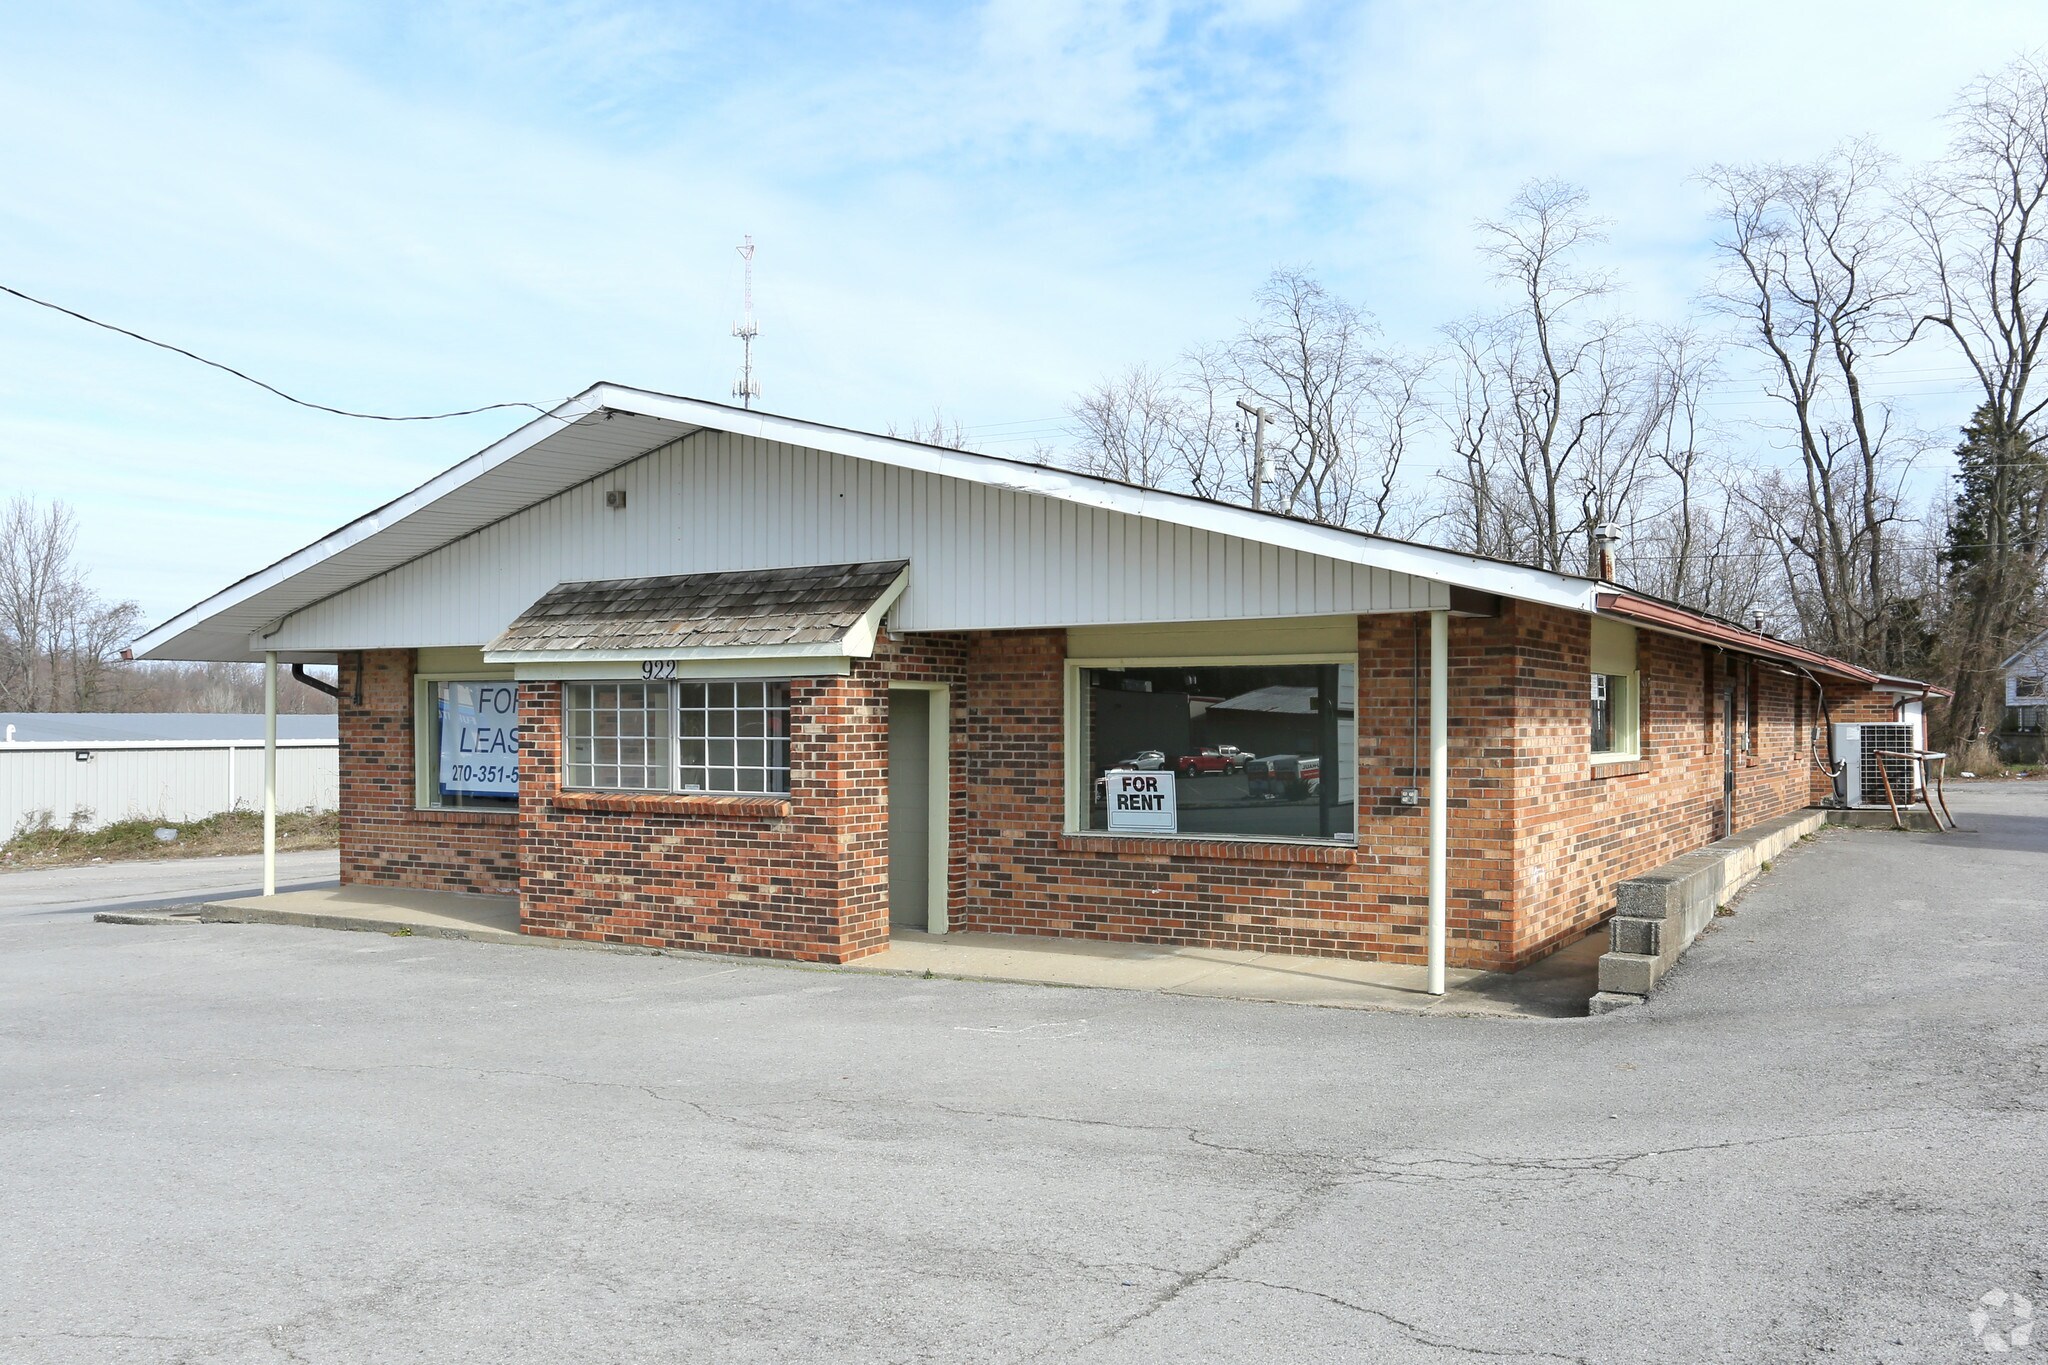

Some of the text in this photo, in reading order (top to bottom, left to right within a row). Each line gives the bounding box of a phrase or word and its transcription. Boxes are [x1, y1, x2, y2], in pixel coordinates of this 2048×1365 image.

[642, 660, 676, 680] 922
[452, 764, 518, 783] 270-351-5
[1122, 776, 1158, 792] FOR
[1117, 794, 1164, 811] RENT
